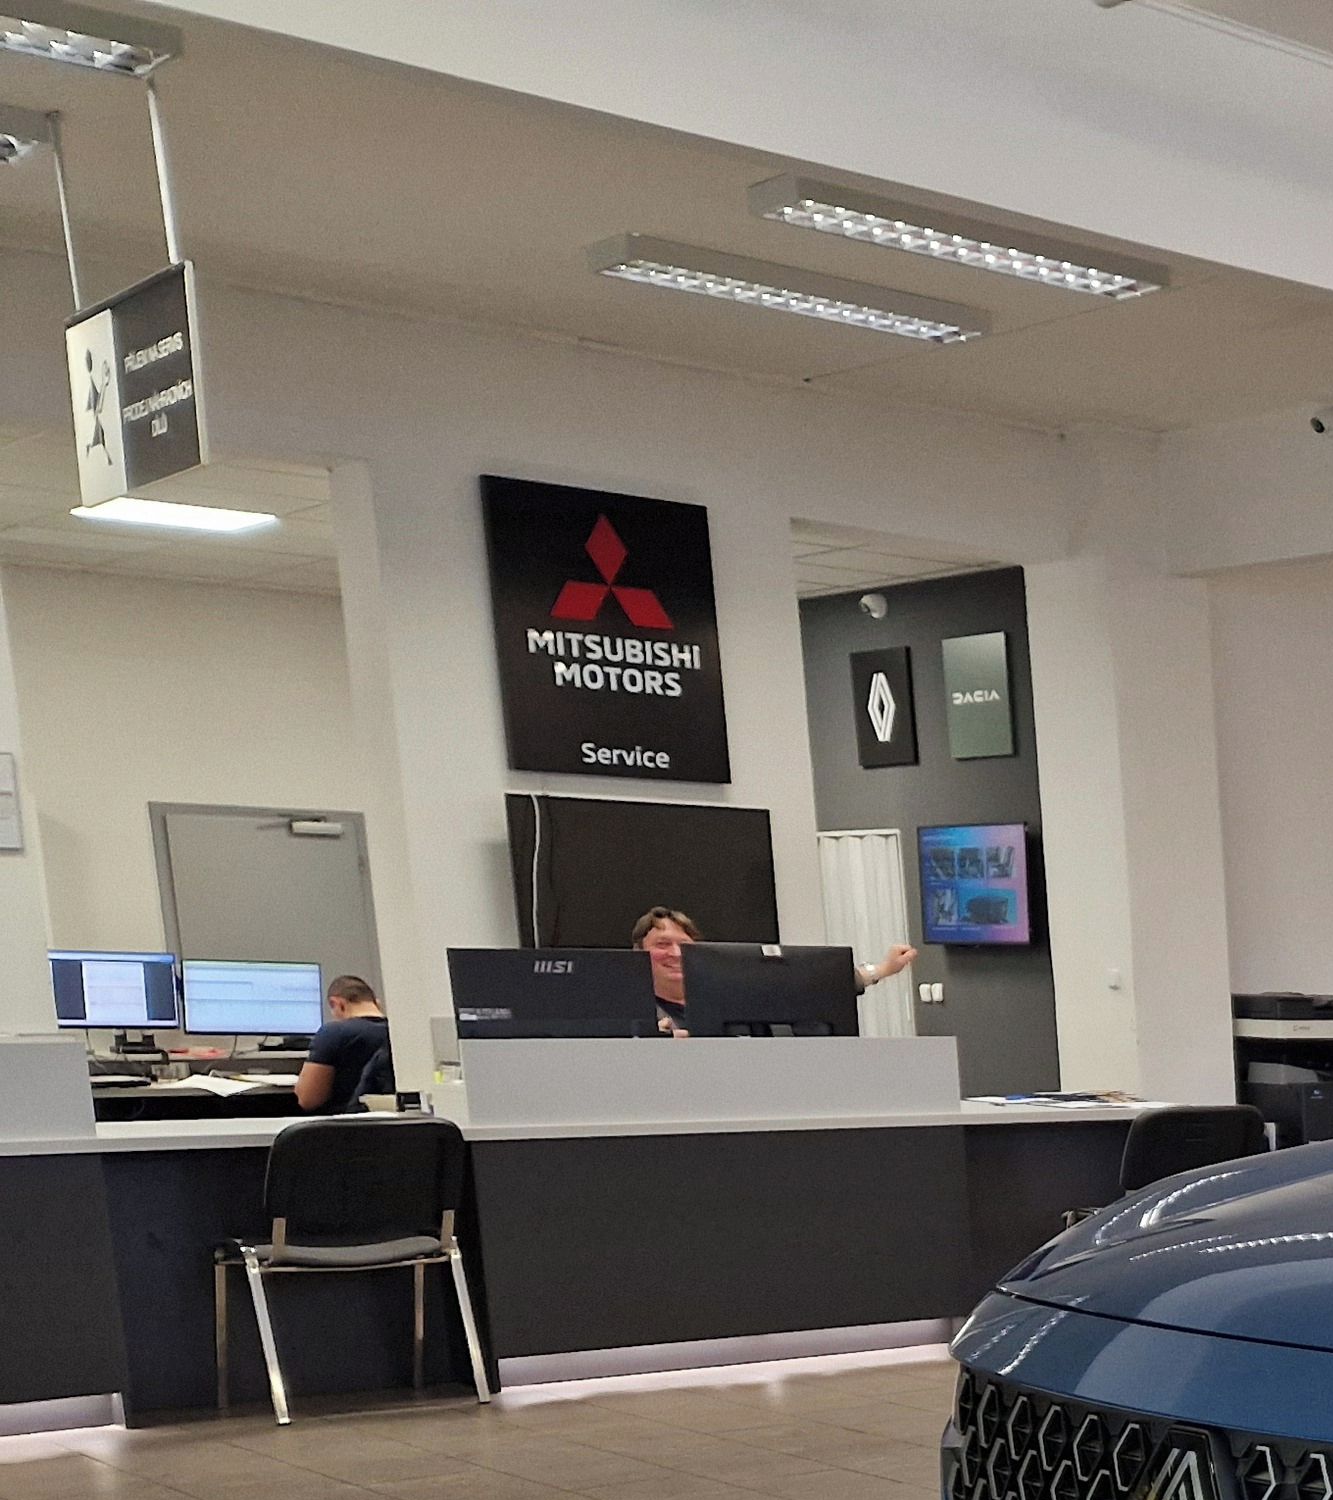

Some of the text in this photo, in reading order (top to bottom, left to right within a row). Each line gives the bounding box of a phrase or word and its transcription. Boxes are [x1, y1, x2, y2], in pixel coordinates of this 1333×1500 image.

[526, 628, 701, 669] MITSUBISHI
[554, 661, 682, 697] MOTORS
[952, 689, 1000, 705] DACIA
[581, 742, 670, 769] Service
[534, 960, 573, 974] MSI
